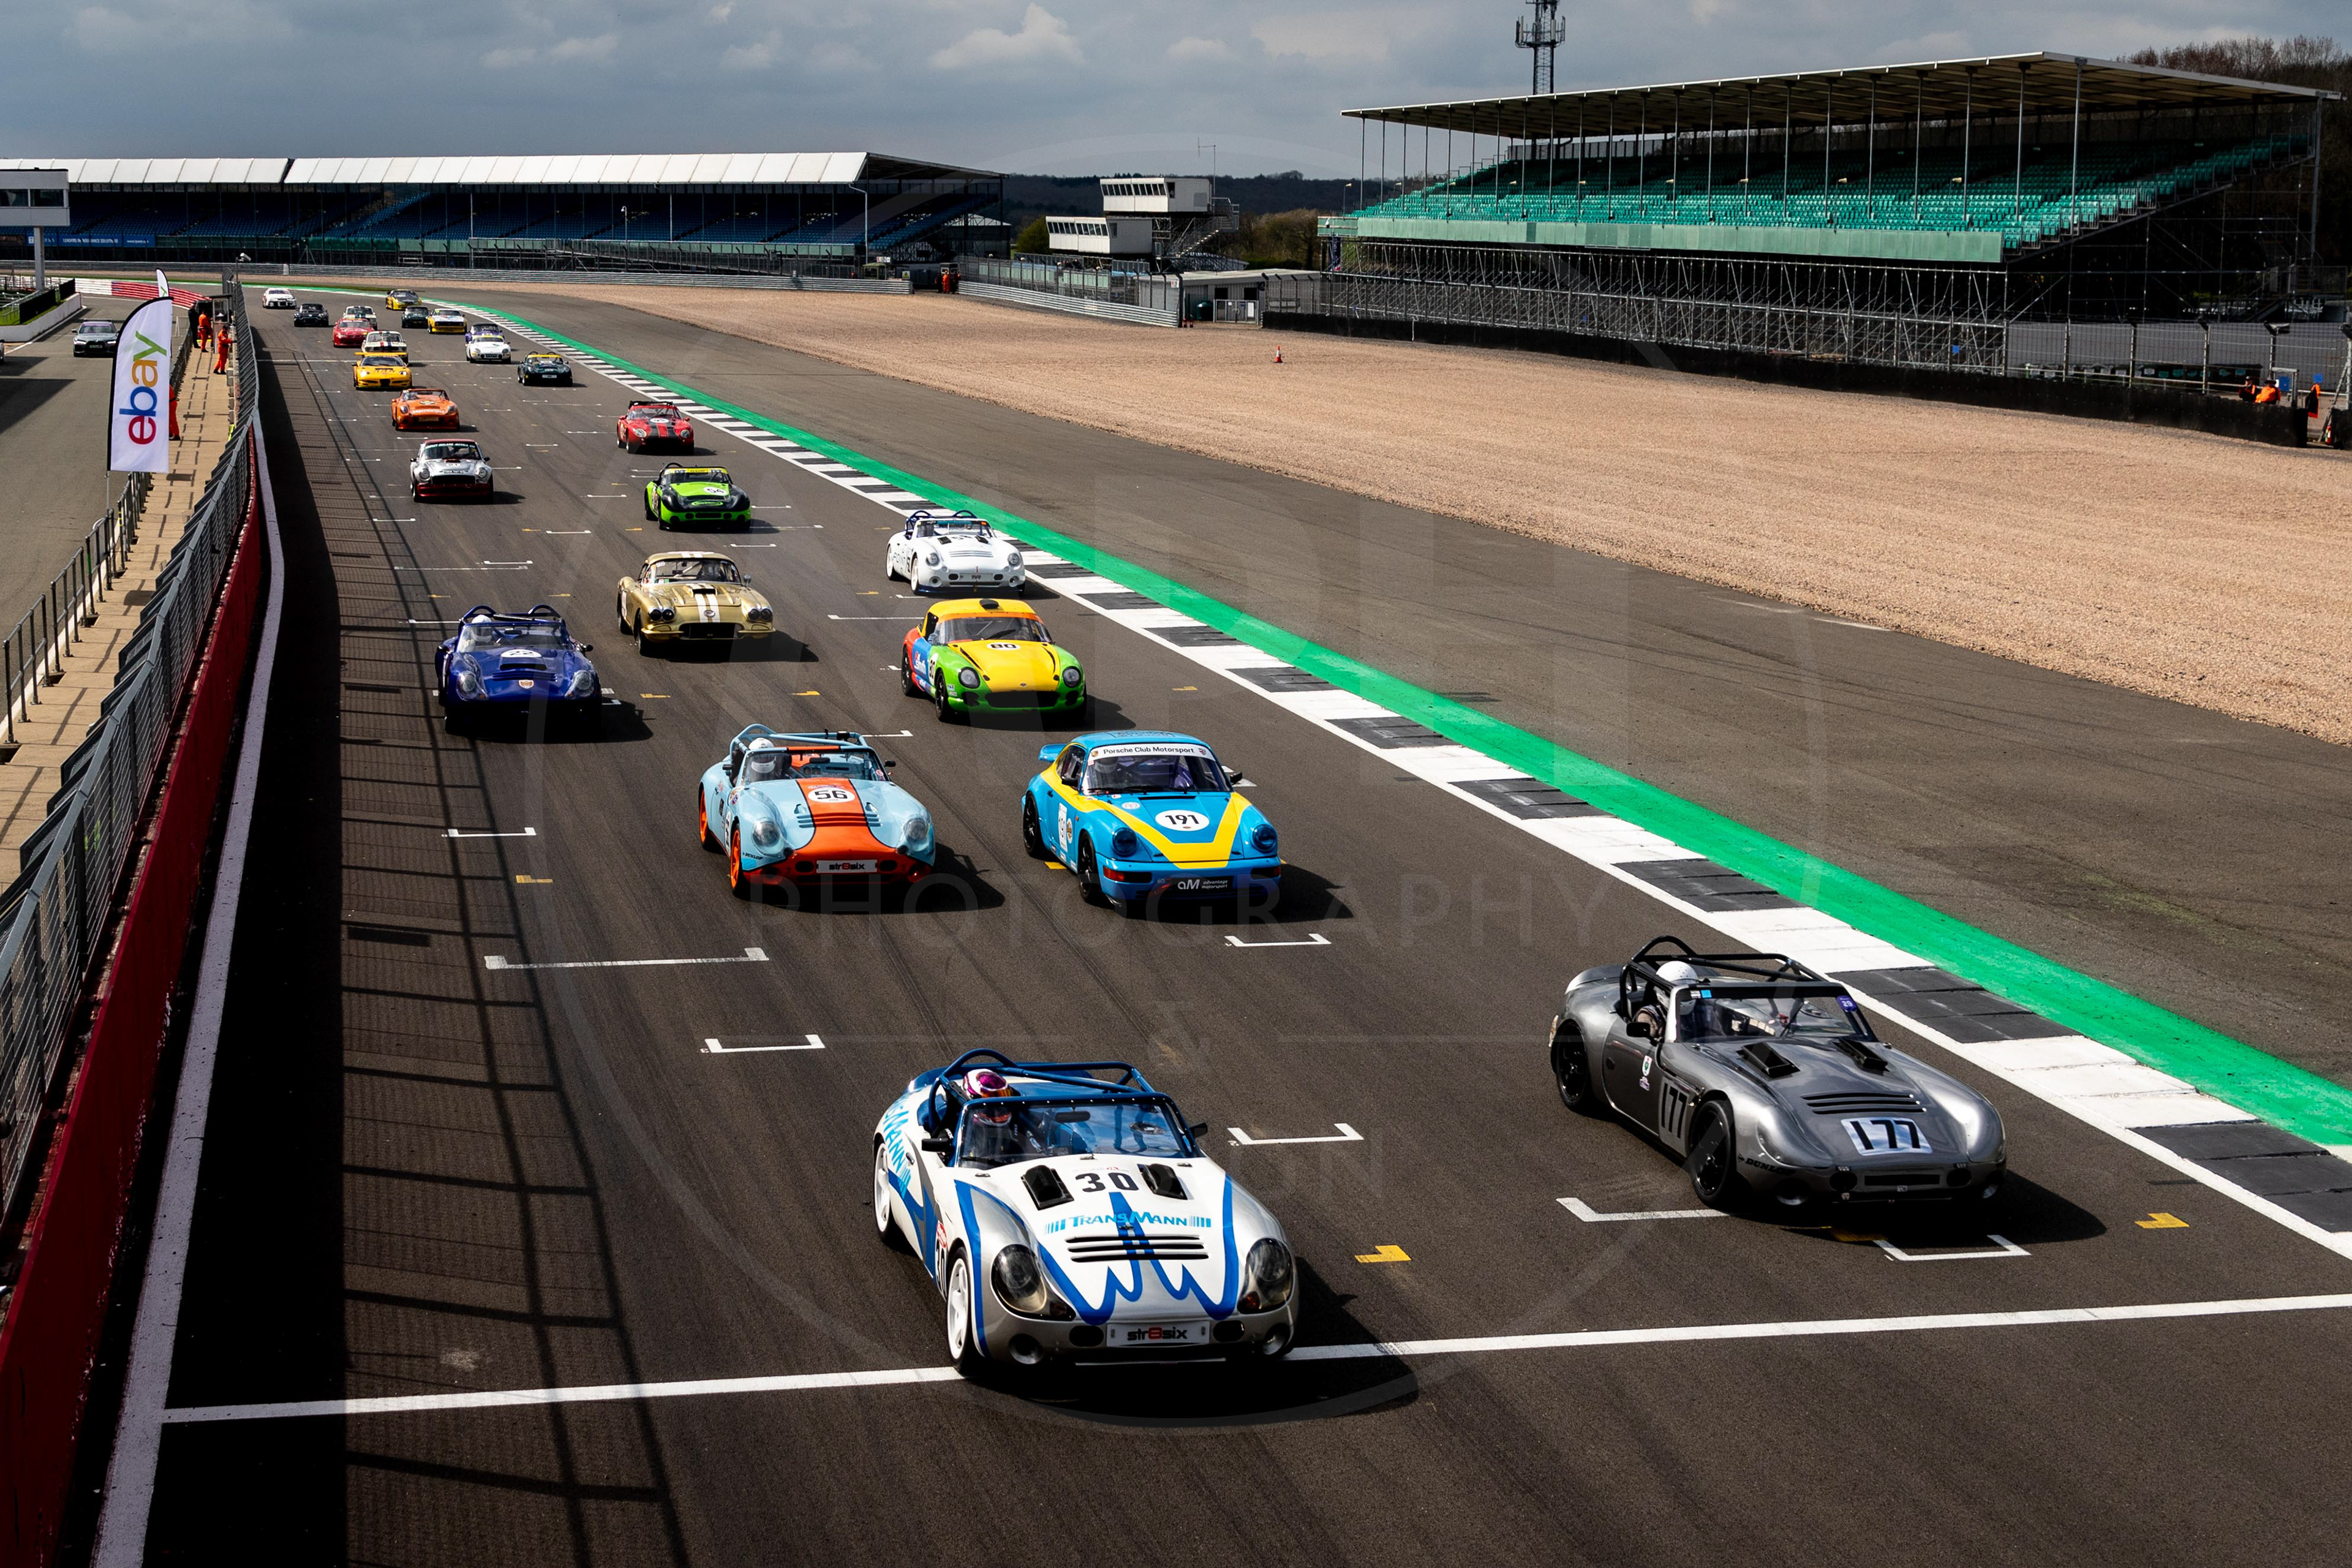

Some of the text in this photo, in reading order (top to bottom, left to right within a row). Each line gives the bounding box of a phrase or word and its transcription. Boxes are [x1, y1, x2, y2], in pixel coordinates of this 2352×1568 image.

[119, 331, 167, 445] ebay
[815, 790, 848, 799] 56
[1165, 815, 1199, 824] 191
[1661, 1082, 1688, 1139] 177
[1850, 1119, 1921, 1150] 177
[1745, 1158, 1796, 1175] DUNLOP
[1075, 1172, 1139, 1193] 30
[1128, 1327, 1188, 1341] str8six
